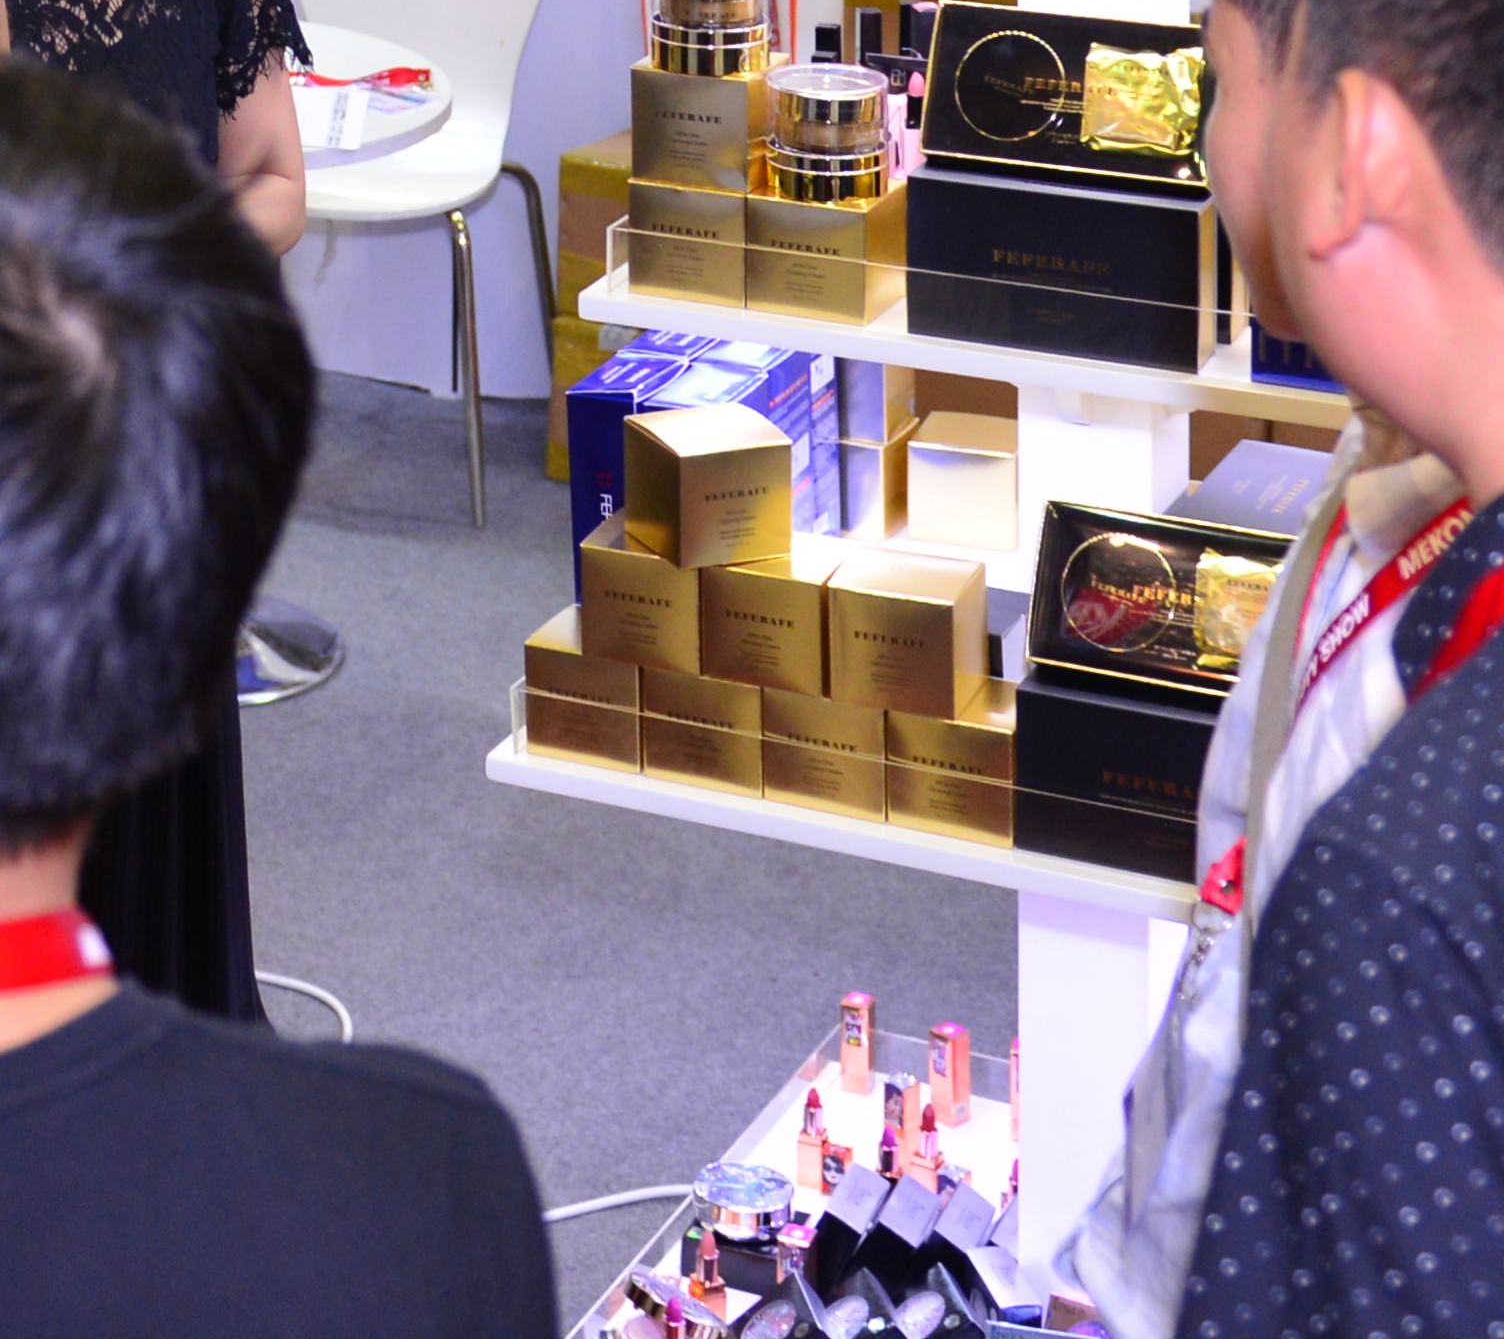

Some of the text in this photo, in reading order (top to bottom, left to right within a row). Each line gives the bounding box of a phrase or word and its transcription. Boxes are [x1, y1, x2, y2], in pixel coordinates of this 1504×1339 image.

[654, 110, 723, 126] FEFERAFE
[651, 222, 720, 240] FEFERAFE
[770, 239, 841, 257] FEFERAFE
[992, 248, 1112, 275] FEFERAFE
[704, 485, 771, 503] FEFERAFE
[603, 588, 674, 610] FEFERAFE
[724, 609, 796, 630] FEFERAFE
[1318, 592, 1371, 664] SHOW
[853, 630, 927, 650] FEFERAFE
[786, 731, 859, 754] FEFERAFE
[912, 753, 984, 777] FEFERAFE
[1102, 768, 1194, 799] FEFERA
